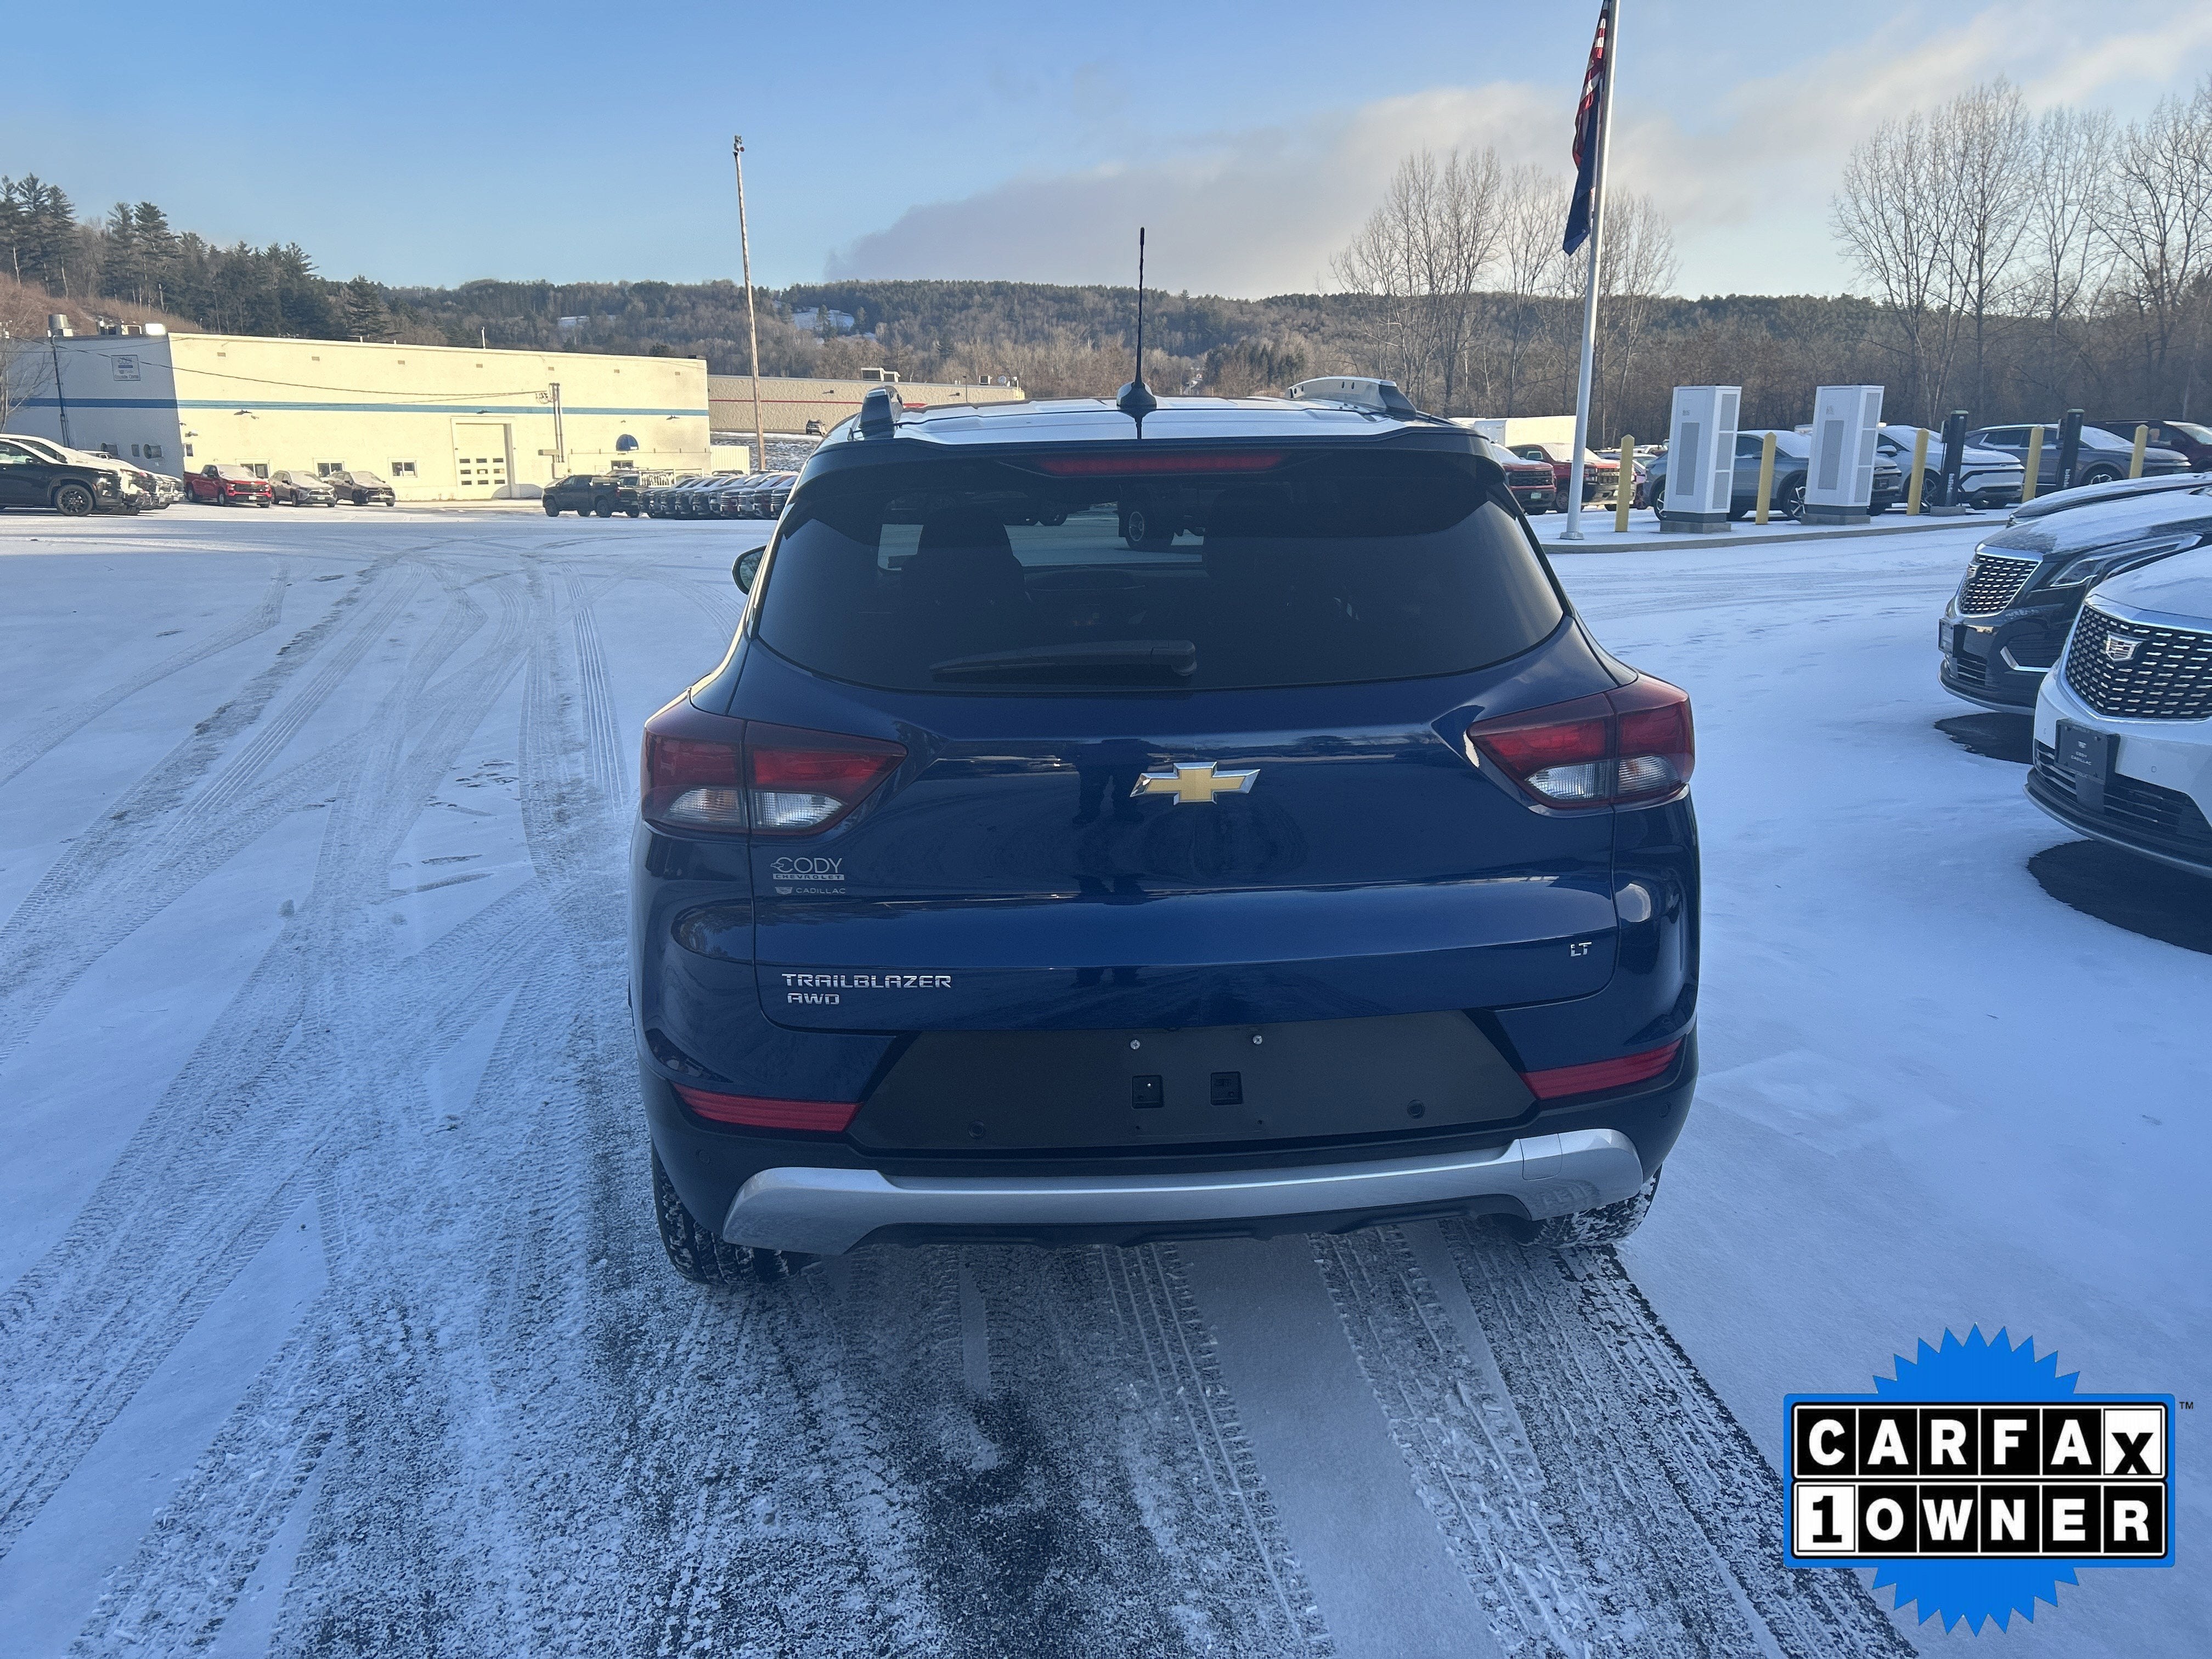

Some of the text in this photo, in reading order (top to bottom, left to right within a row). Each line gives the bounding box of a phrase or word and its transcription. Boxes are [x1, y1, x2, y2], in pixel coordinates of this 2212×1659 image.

[770, 856, 843, 873] CODY
[1570, 941, 1593, 957] LT
[781, 973, 952, 989] TRAILBLAZER
[787, 992, 840, 1005] AWD
